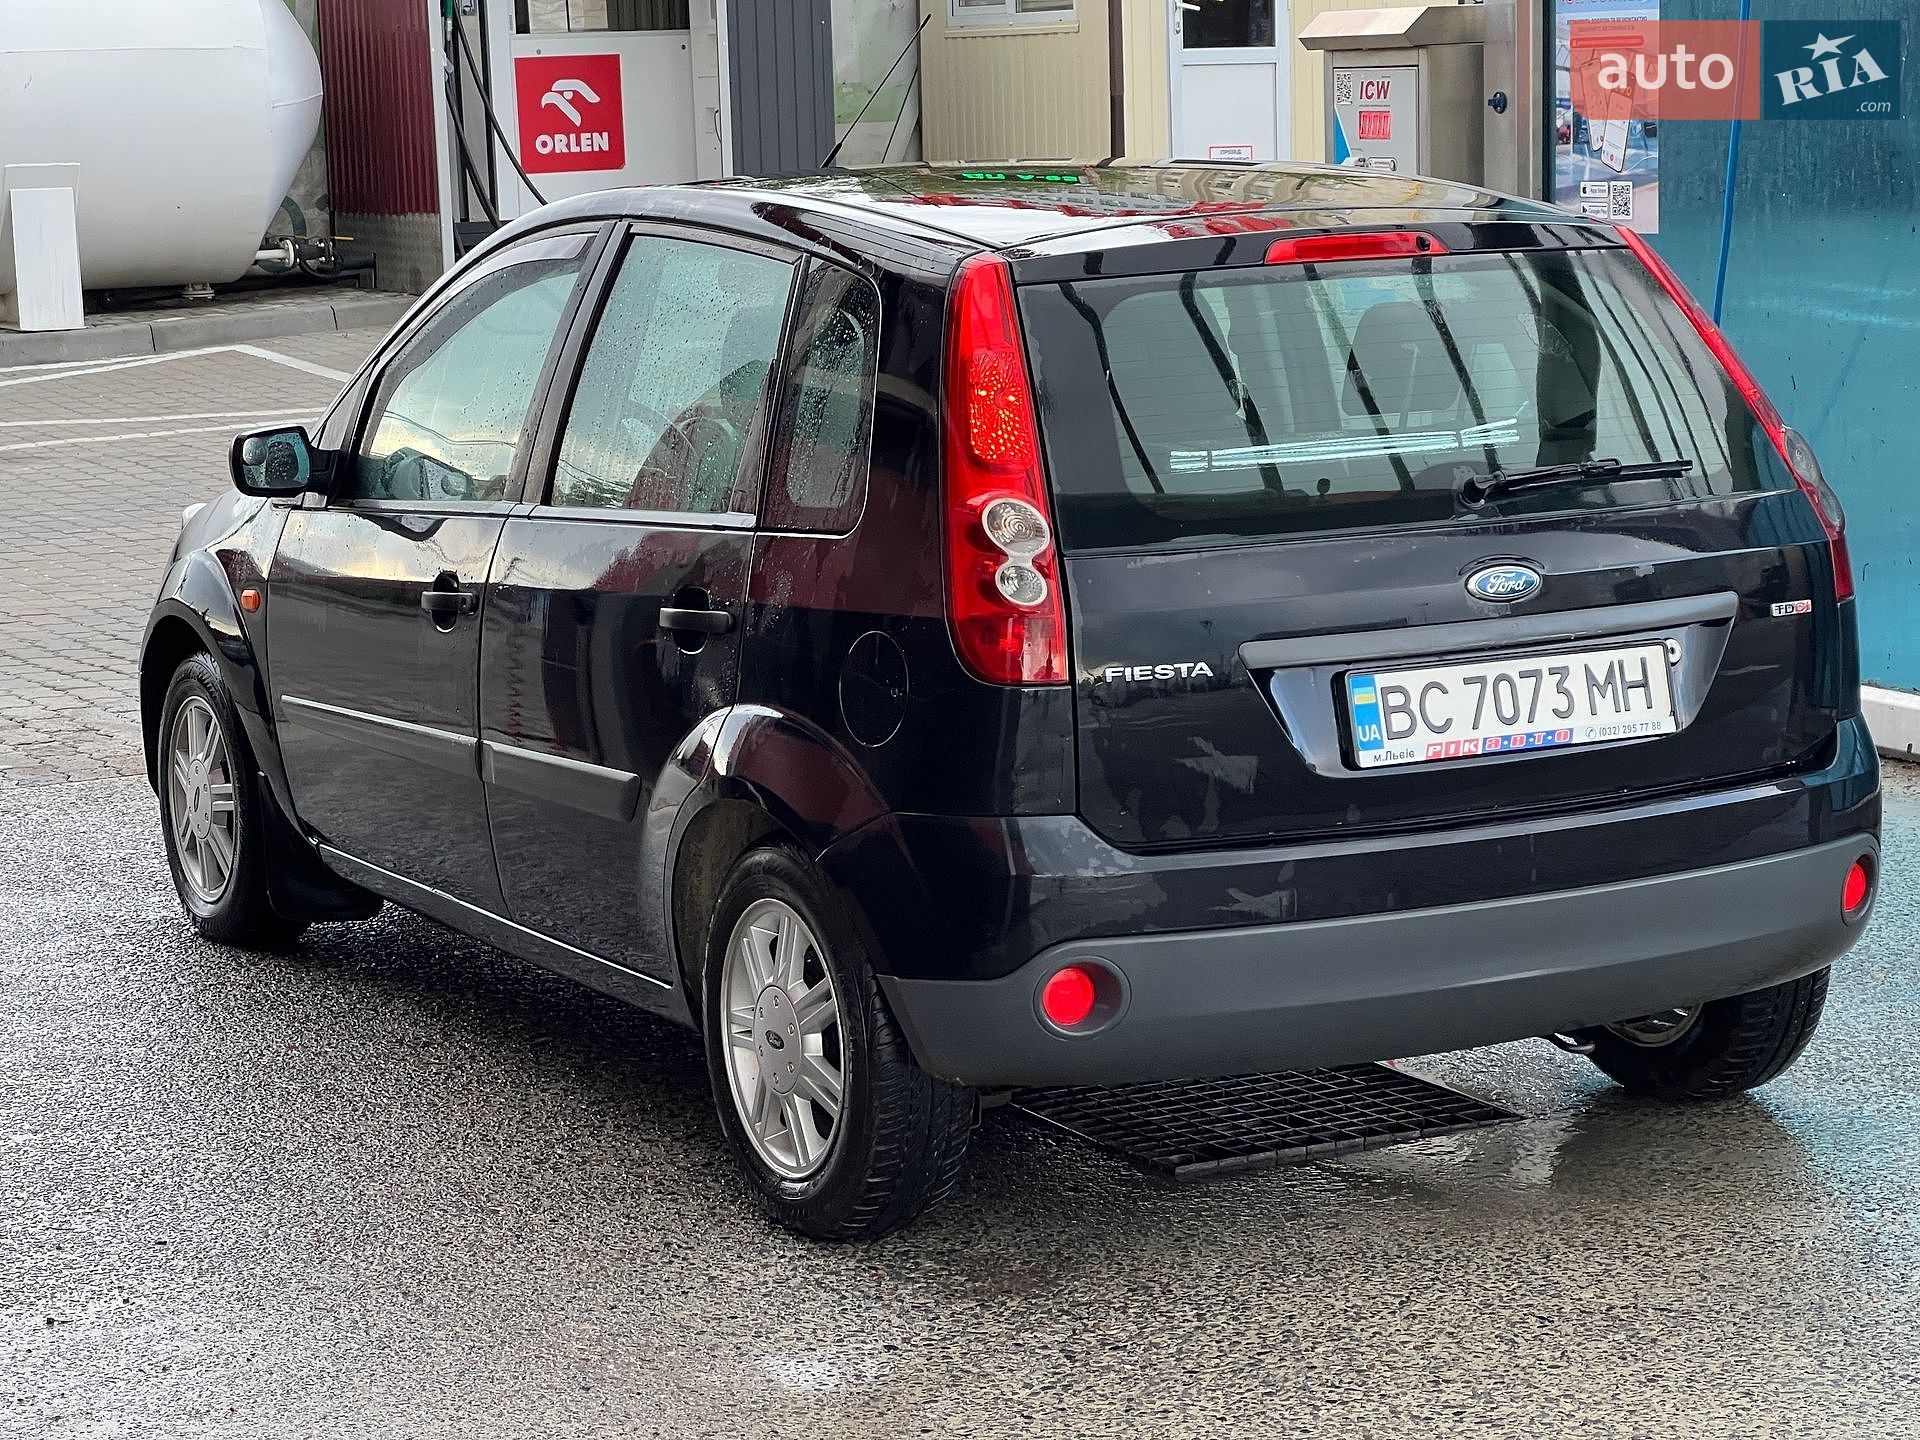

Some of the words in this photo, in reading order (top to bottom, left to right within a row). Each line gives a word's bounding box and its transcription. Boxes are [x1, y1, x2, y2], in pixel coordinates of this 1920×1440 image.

[1359, 80, 1390, 99] ICW
[535, 132, 609, 154] ORLEN
[1487, 572, 1528, 594] Ford
[1105, 661, 1214, 683] FIESTA
[1381, 681, 1453, 740] BC
[1463, 666, 1575, 730] 7073
[1584, 657, 1653, 715] MH
[1358, 722, 1381, 743] UA
[1599, 725, 1620, 737] (032)
[1622, 724, 1637, 734] 295
[1639, 723, 1649, 732] 77
